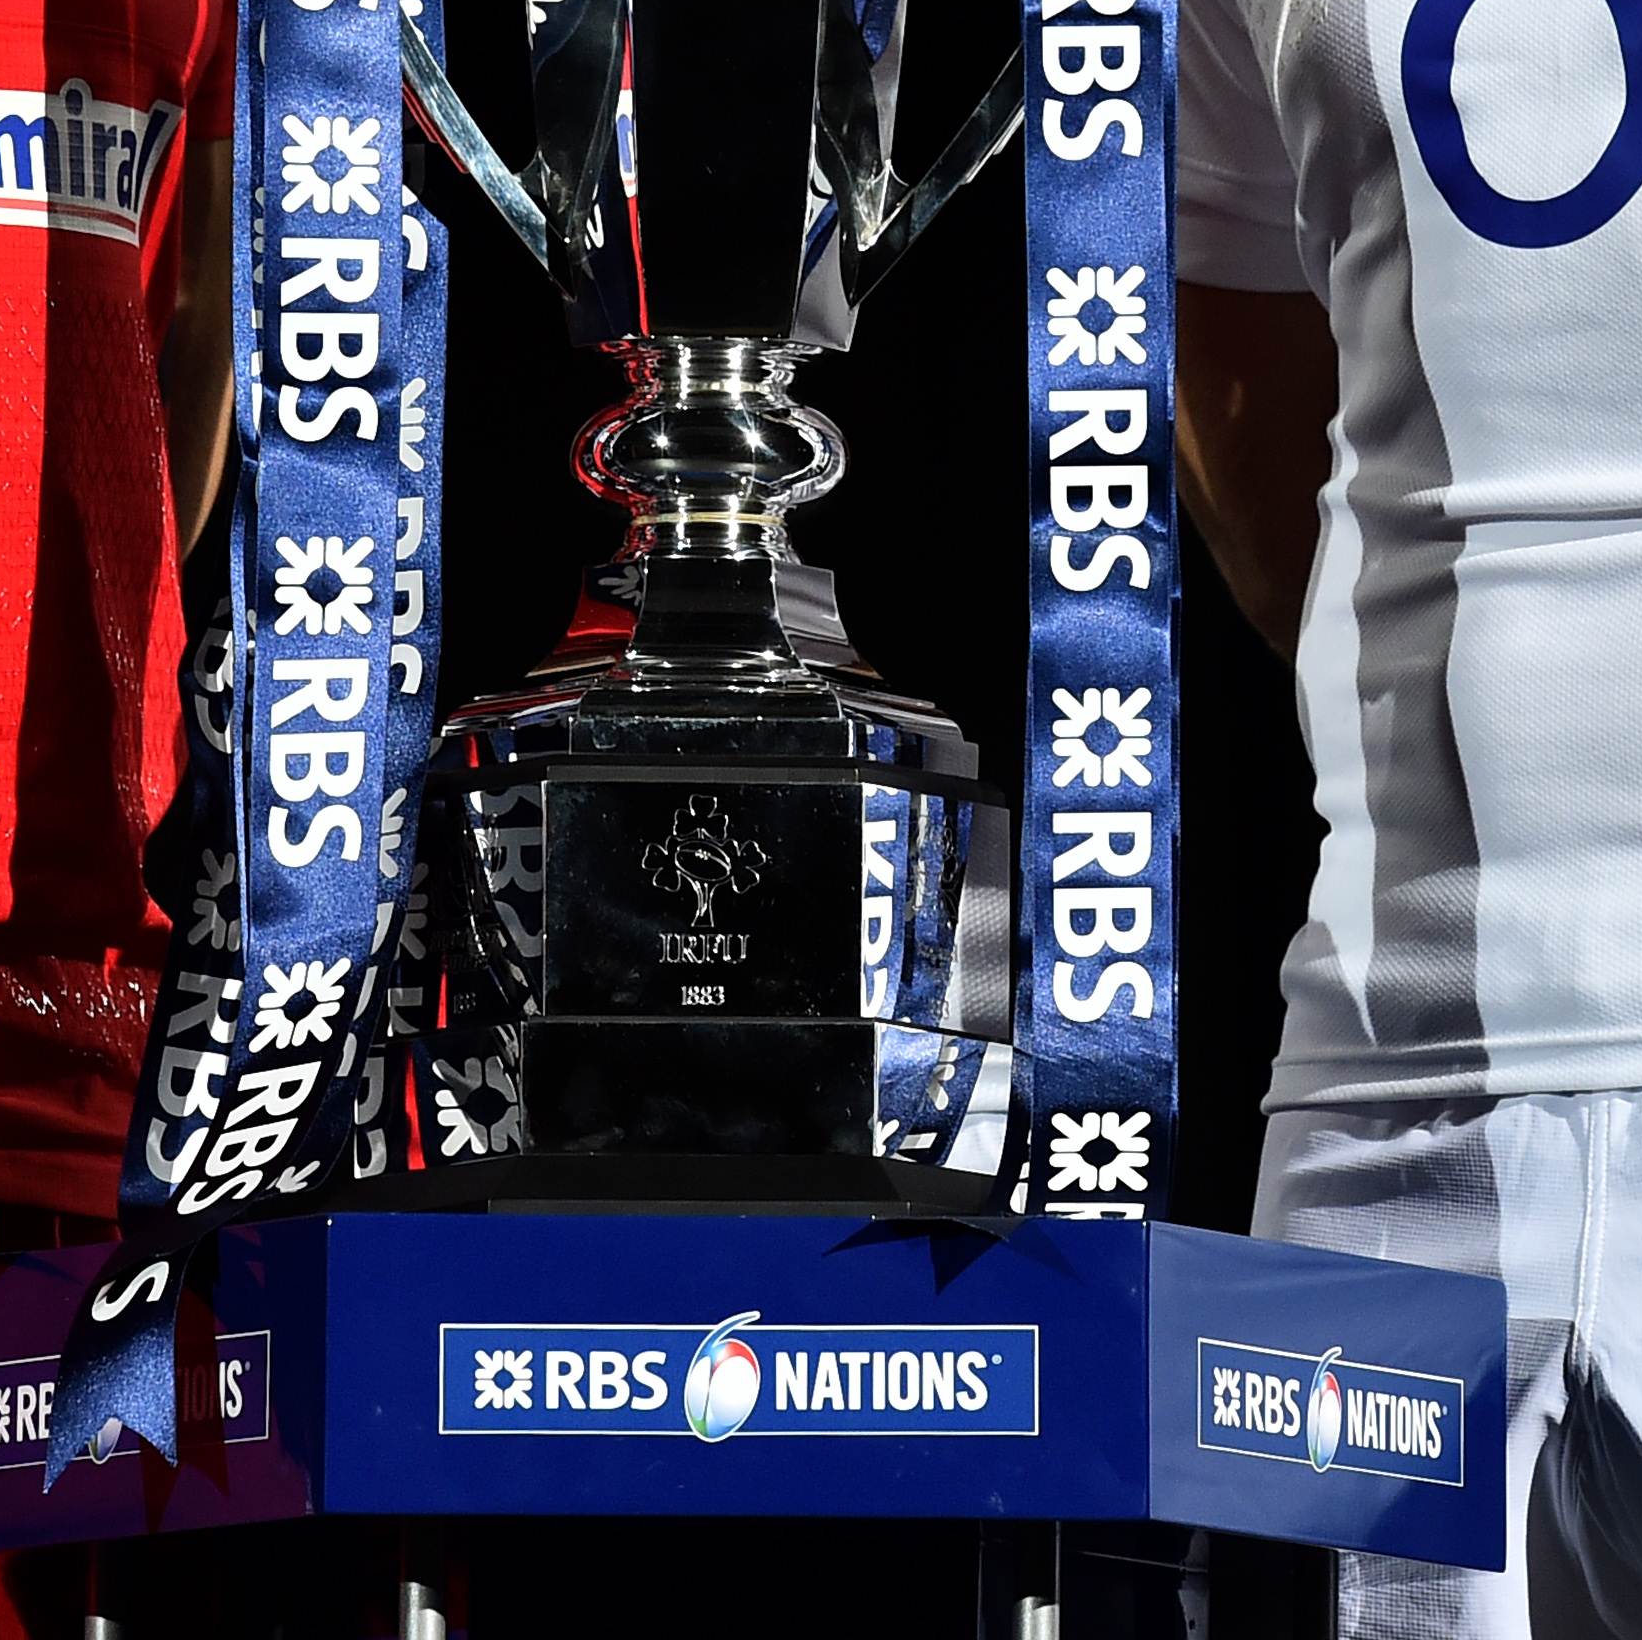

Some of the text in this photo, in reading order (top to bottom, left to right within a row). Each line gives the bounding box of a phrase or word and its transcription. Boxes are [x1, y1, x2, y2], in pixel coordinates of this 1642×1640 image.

[278, 238, 381, 442] RBS
[1048, 389, 1151, 592] RBS
[268, 658, 370, 868] RBS
[659, 933, 750, 964] IRFU
[1052, 812, 1155, 1023] RBS
[680, 985, 725, 1006] 1883
[177, 1061, 321, 1214] RBS
[17, 1382, 55, 1442] RB
[545, 1350, 668, 1410] RBS
[775, 1351, 989, 1411] NATIONS
[1245, 1372, 1301, 1437] RBS
[1347, 1388, 1442, 1459] NATIONS
